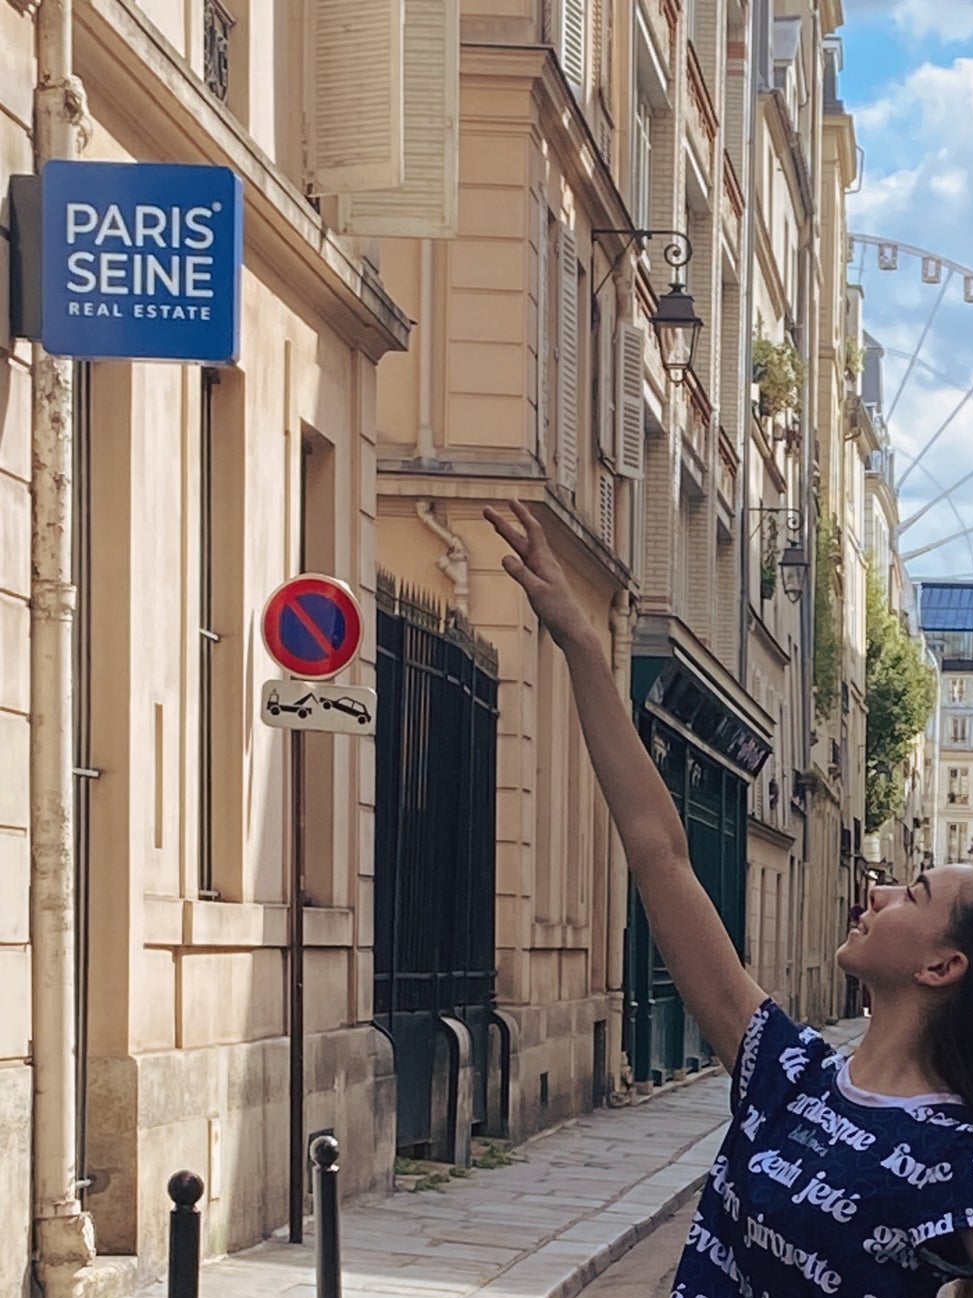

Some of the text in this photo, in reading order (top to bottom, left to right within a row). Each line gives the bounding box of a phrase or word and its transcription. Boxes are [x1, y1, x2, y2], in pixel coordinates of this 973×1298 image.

[66, 203, 215, 250] PARIS
[66, 251, 215, 298] SEINE
[68, 302, 212, 321] REAL ESTATE
[791, 1171, 861, 1223] jeté
